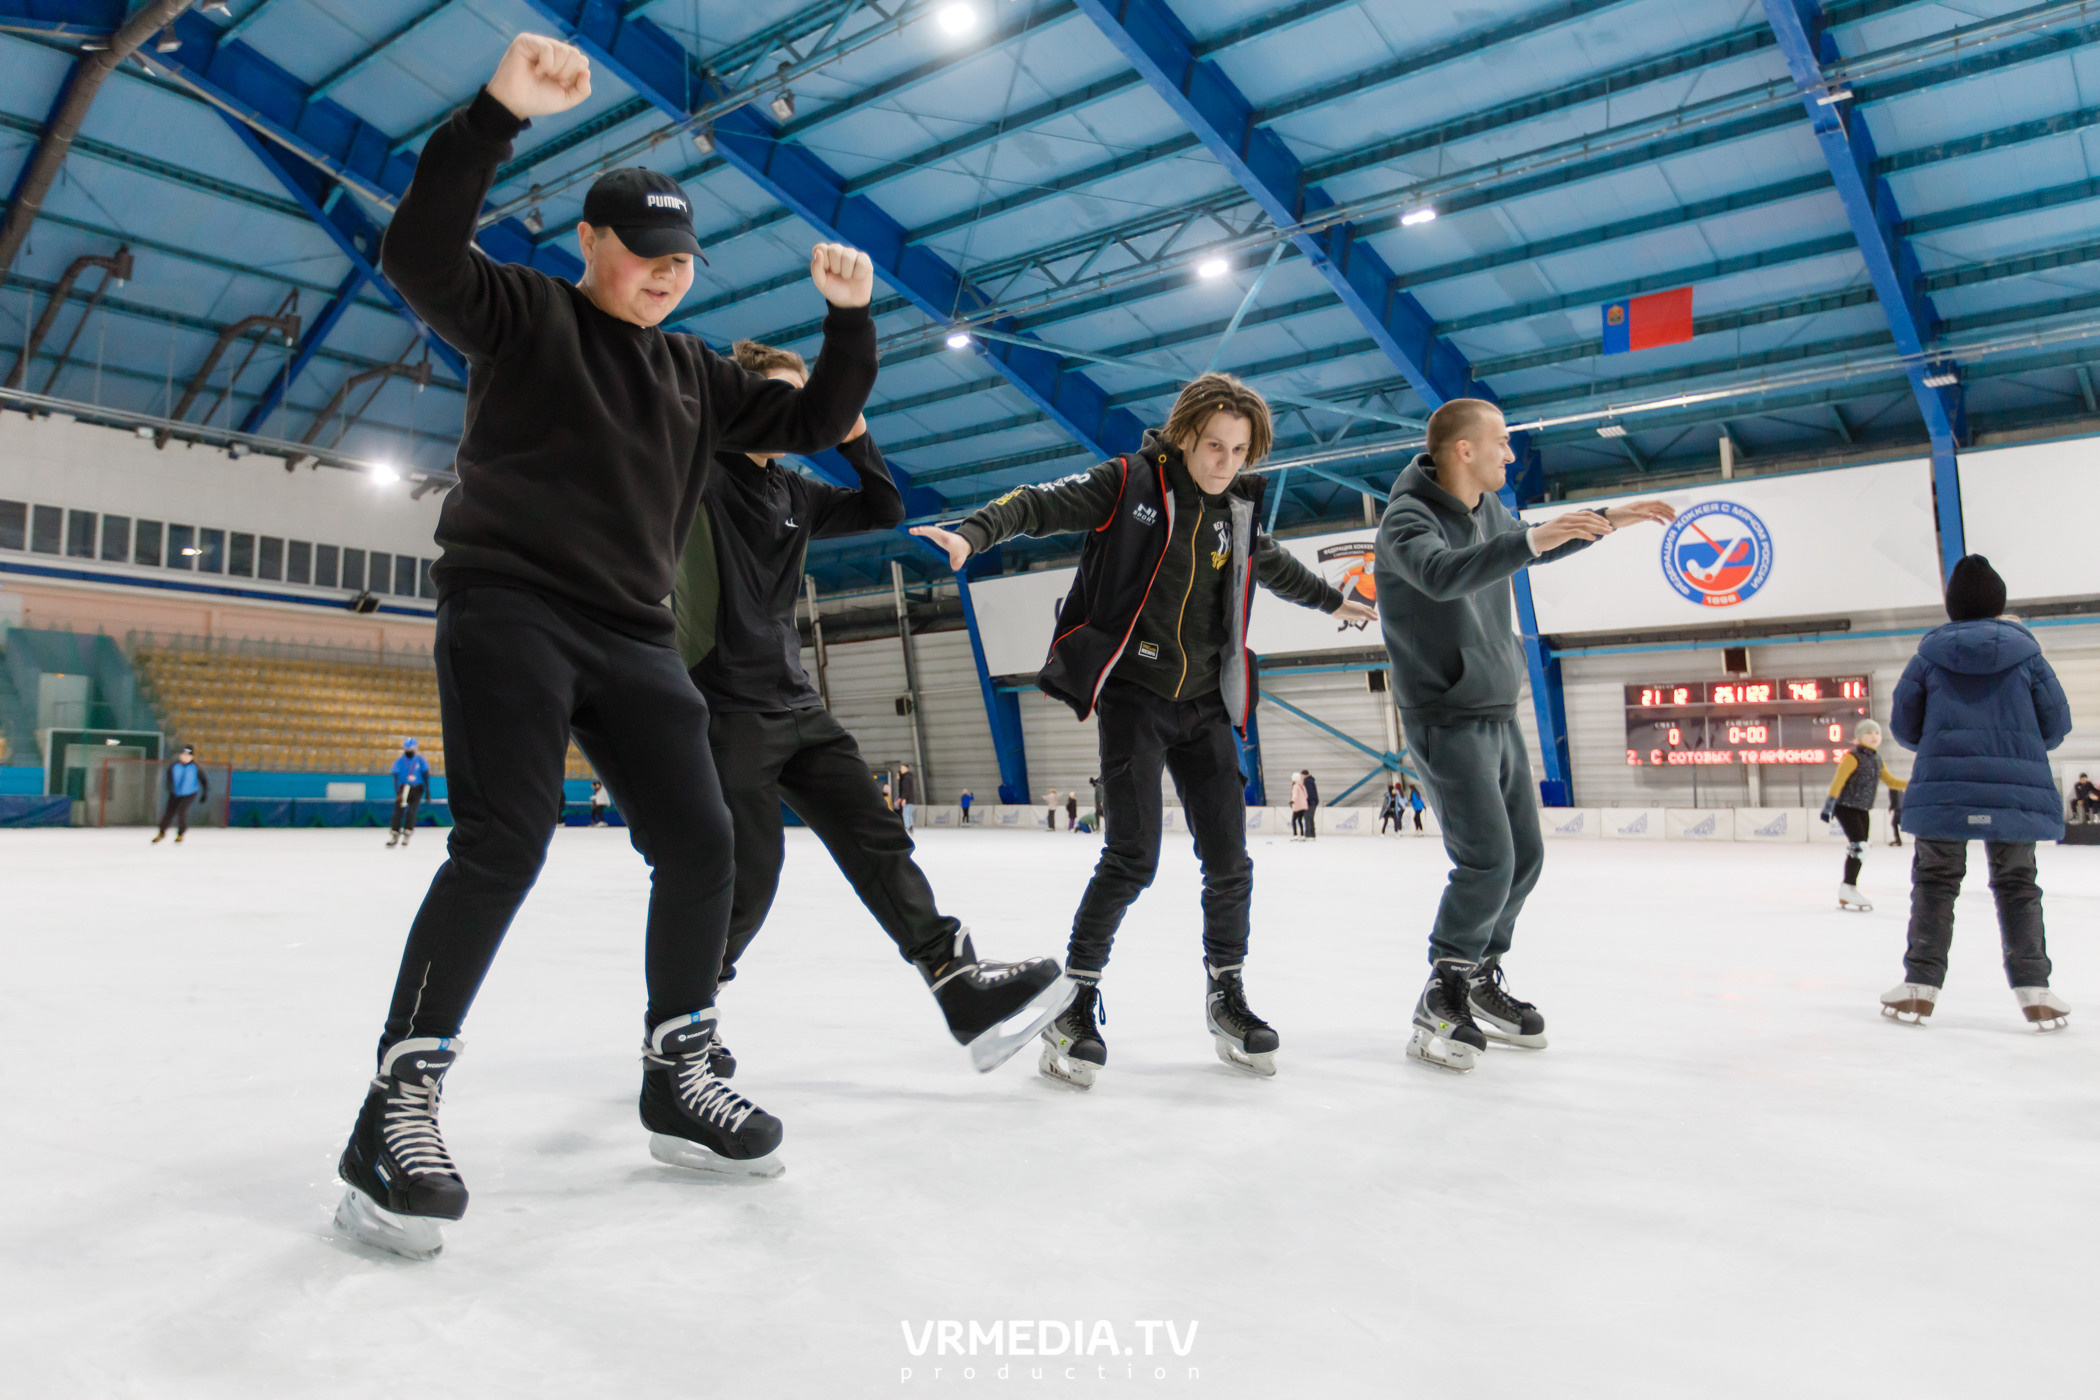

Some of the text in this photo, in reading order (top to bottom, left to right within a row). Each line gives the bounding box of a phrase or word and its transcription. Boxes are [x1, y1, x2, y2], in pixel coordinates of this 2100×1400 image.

[1668, 728, 1680, 745] 0
[1729, 726, 1768, 744] 0-00
[1829, 724, 1842, 742] 0
